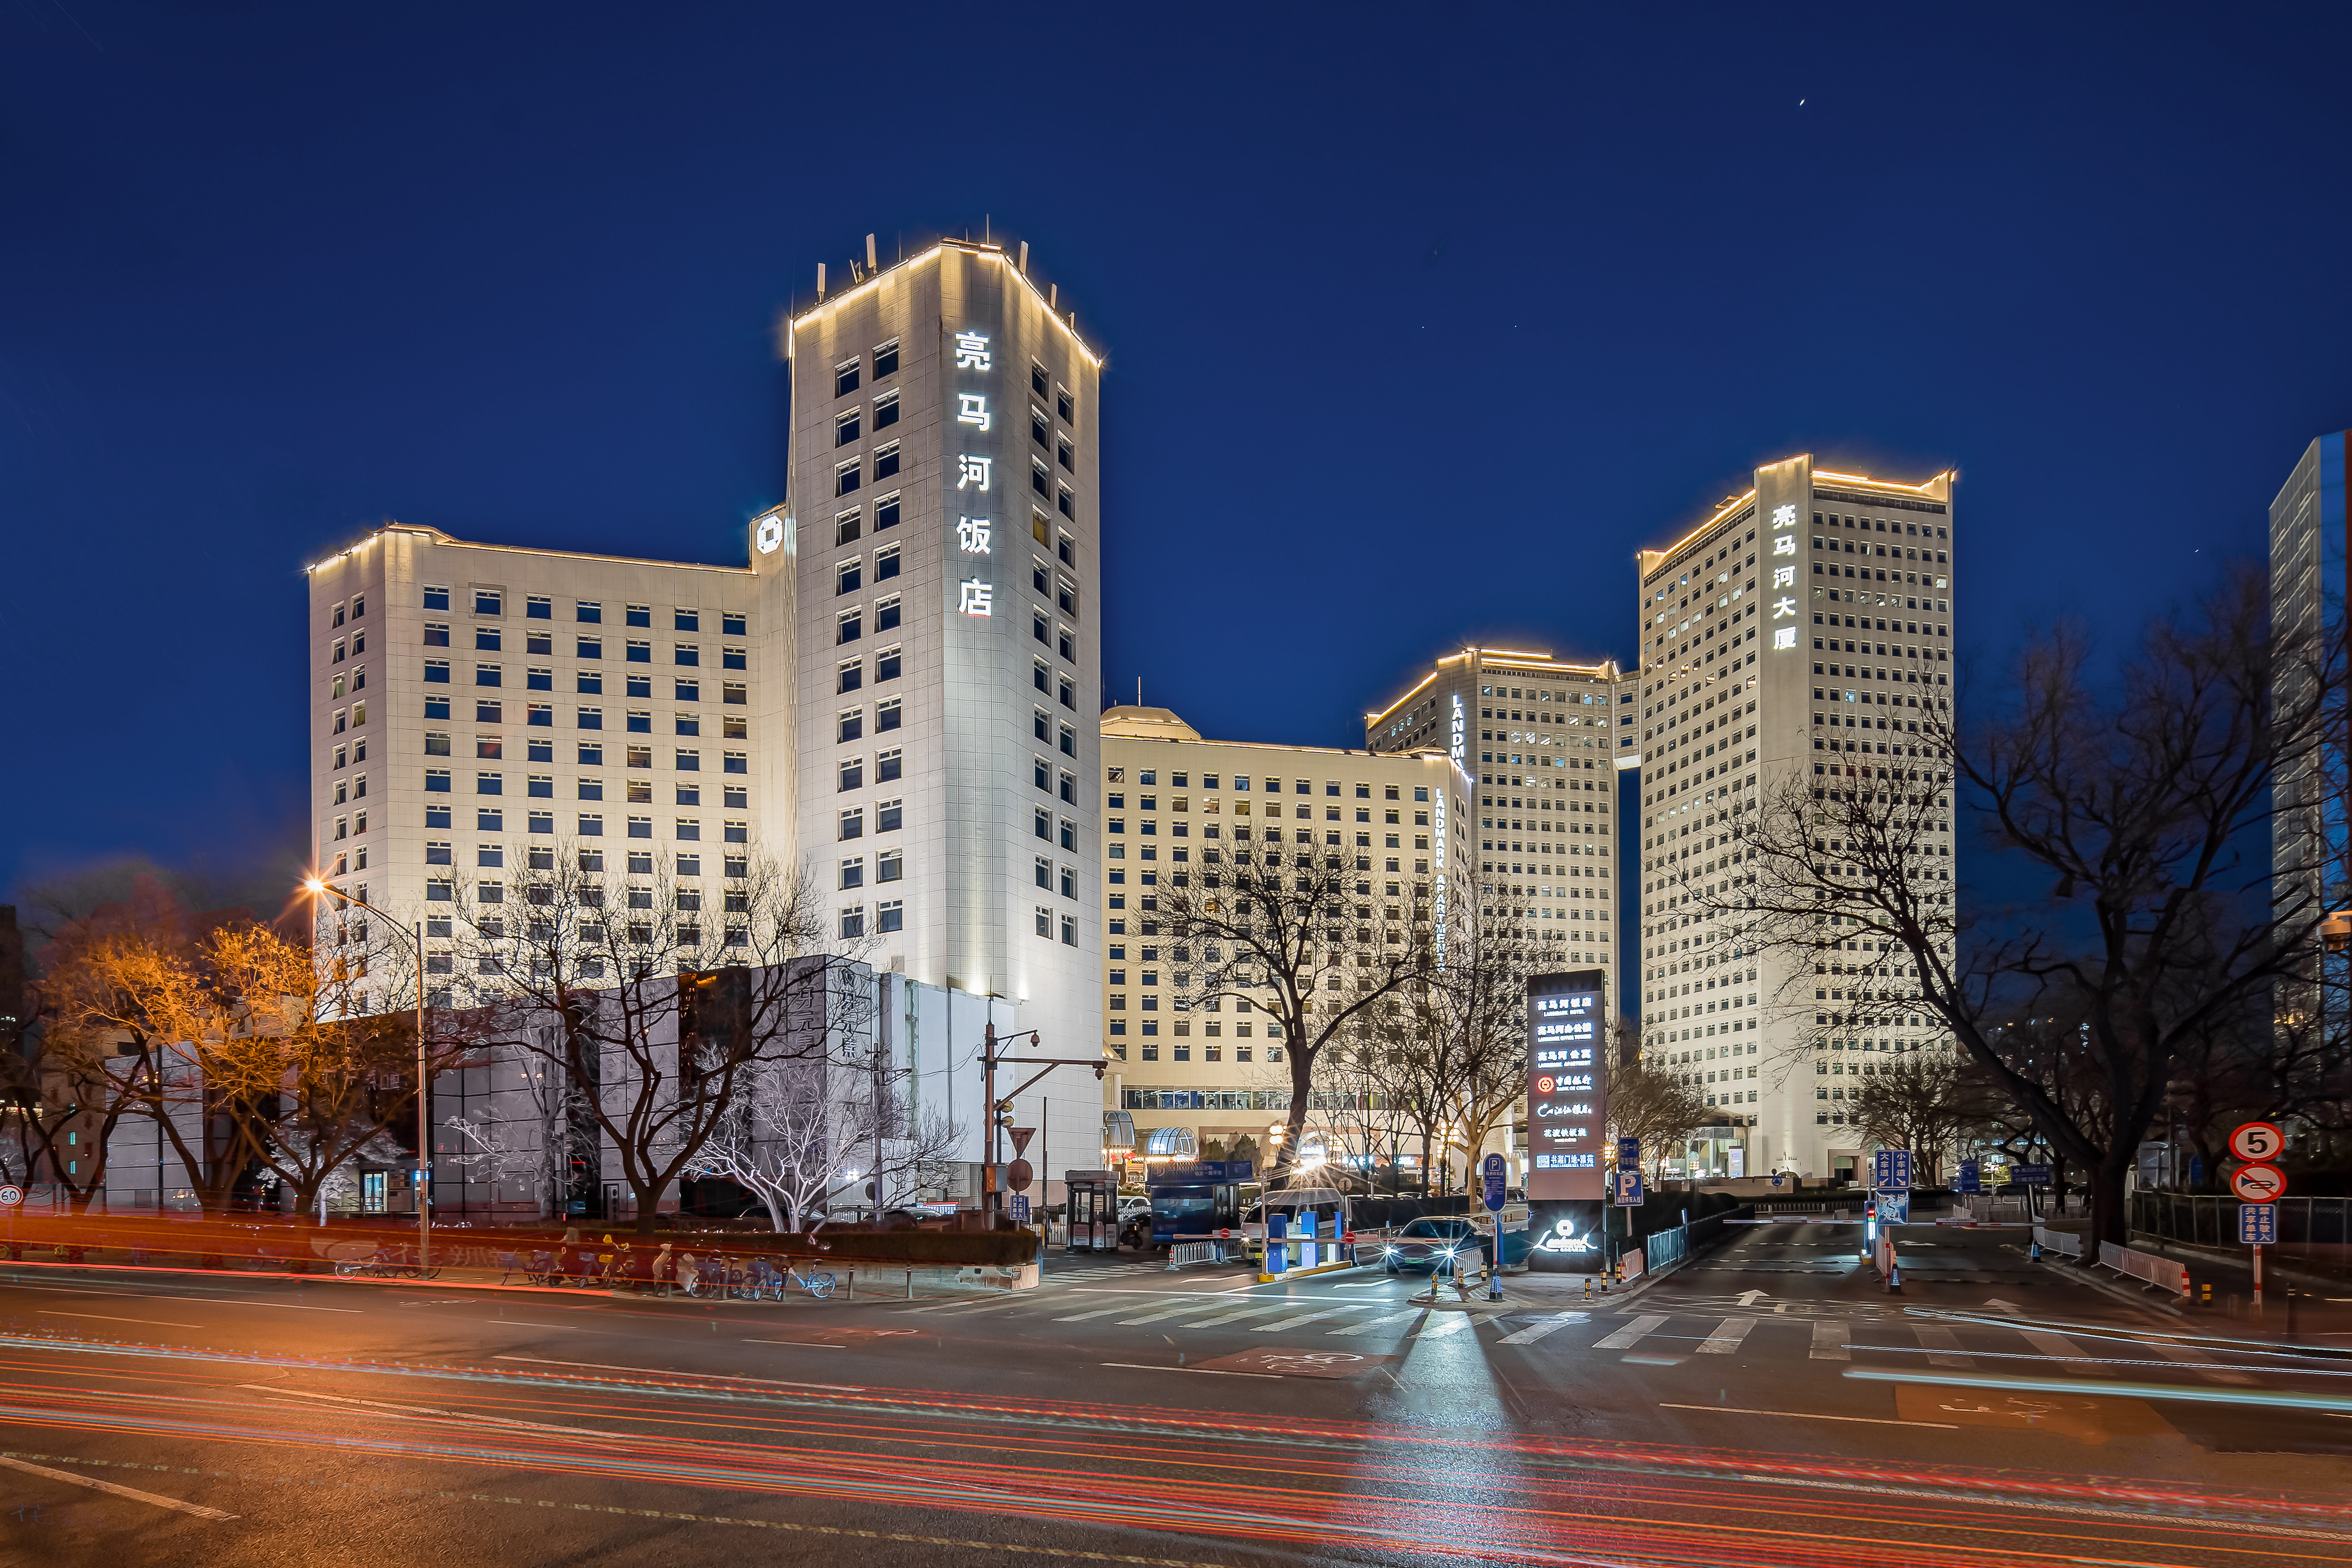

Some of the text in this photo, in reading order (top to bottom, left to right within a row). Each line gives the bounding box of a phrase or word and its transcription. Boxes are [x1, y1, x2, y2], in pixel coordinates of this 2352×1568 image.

[955, 331, 992, 617] 亮马河饭店
[1772, 504, 1796, 651] 亮马河大厦
[1434, 787, 1446, 869] LANDMARK
[1537, 997, 1592, 1011] 亮马河饭店
[1556, 1074, 1592, 1086] 中国银行
[2247, 1131, 2268, 1154] 5
[1880, 1153, 1889, 1176] 大车道
[1896, 1153, 1906, 1176] 小车道
[1, 1190, 17, 1201] 60
[1620, 1175, 1636, 1196] P
[2246, 1207, 2256, 1241] 共享单车
[2259, 1207, 2270, 1241] 禁止驶入
